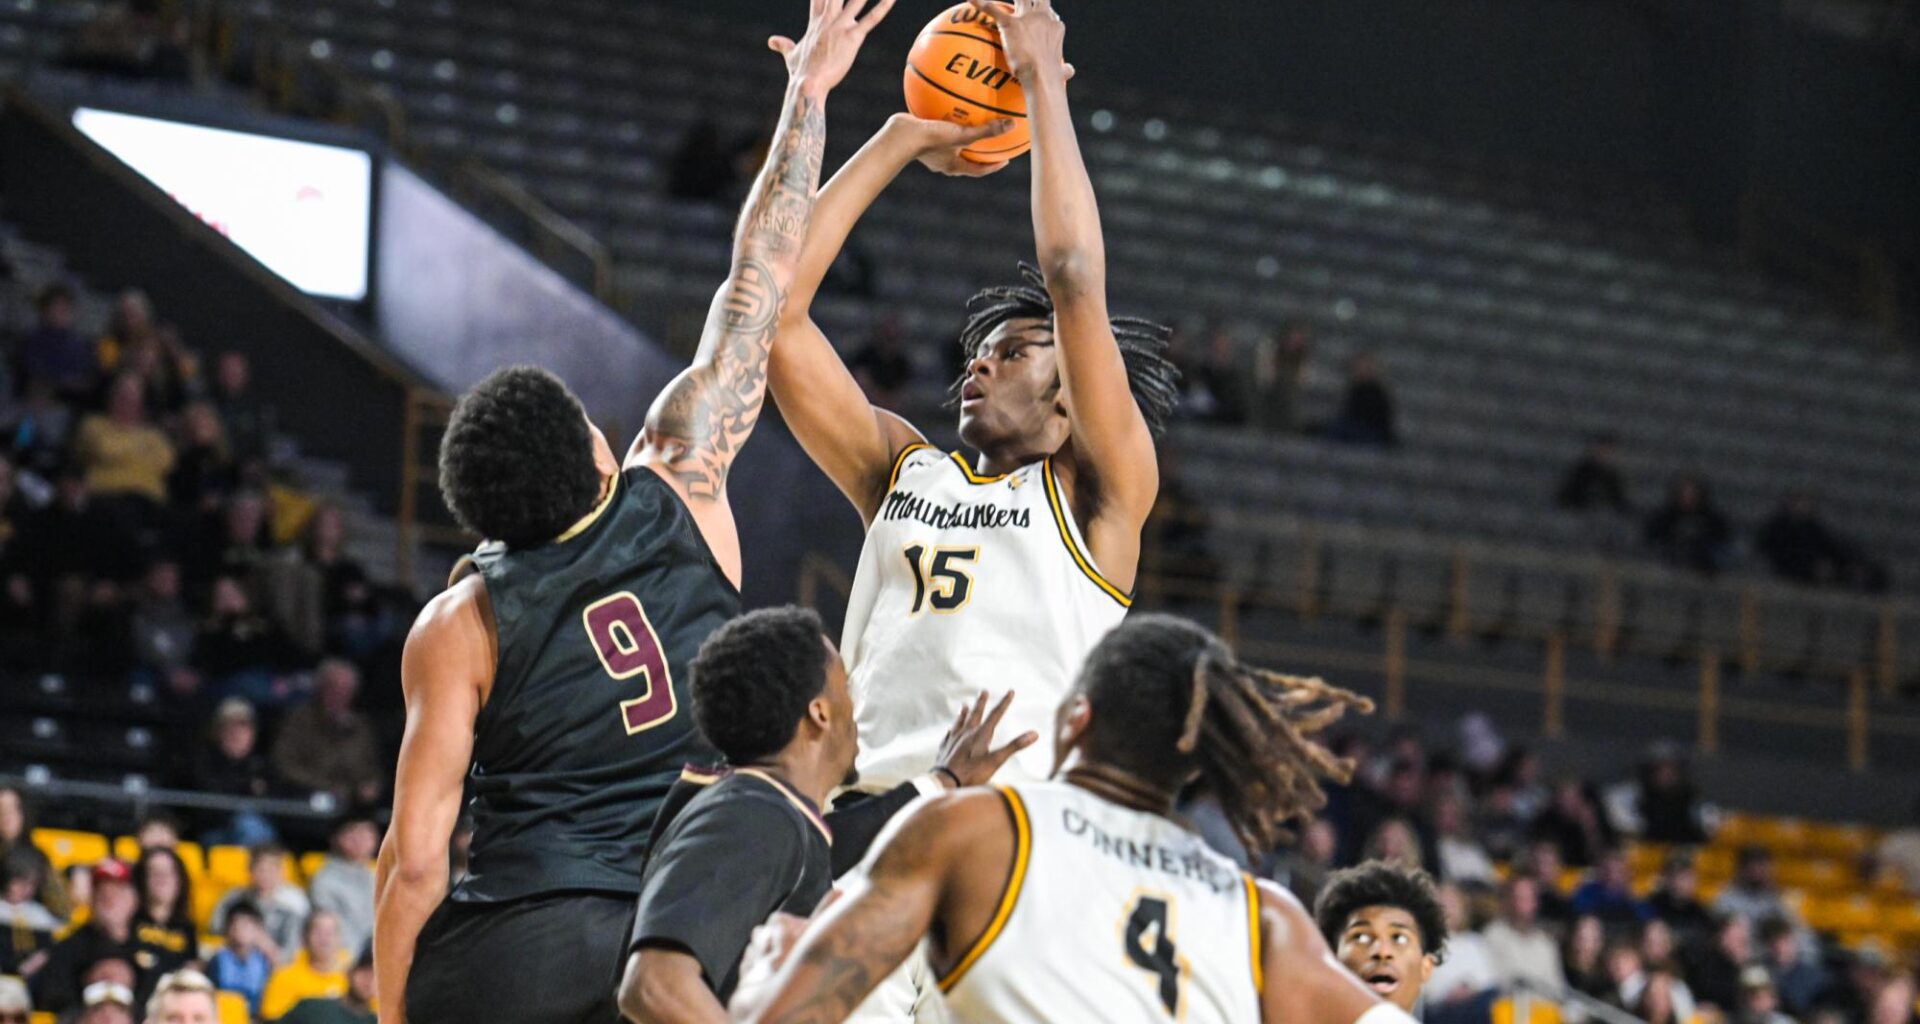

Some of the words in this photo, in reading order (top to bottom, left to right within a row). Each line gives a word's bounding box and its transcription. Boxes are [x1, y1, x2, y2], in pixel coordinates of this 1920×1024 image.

[945, 53, 1011, 91] EVO
[903, 541, 981, 618] 15
[583, 591, 677, 736] 9
[1118, 888, 1189, 1021] 4
